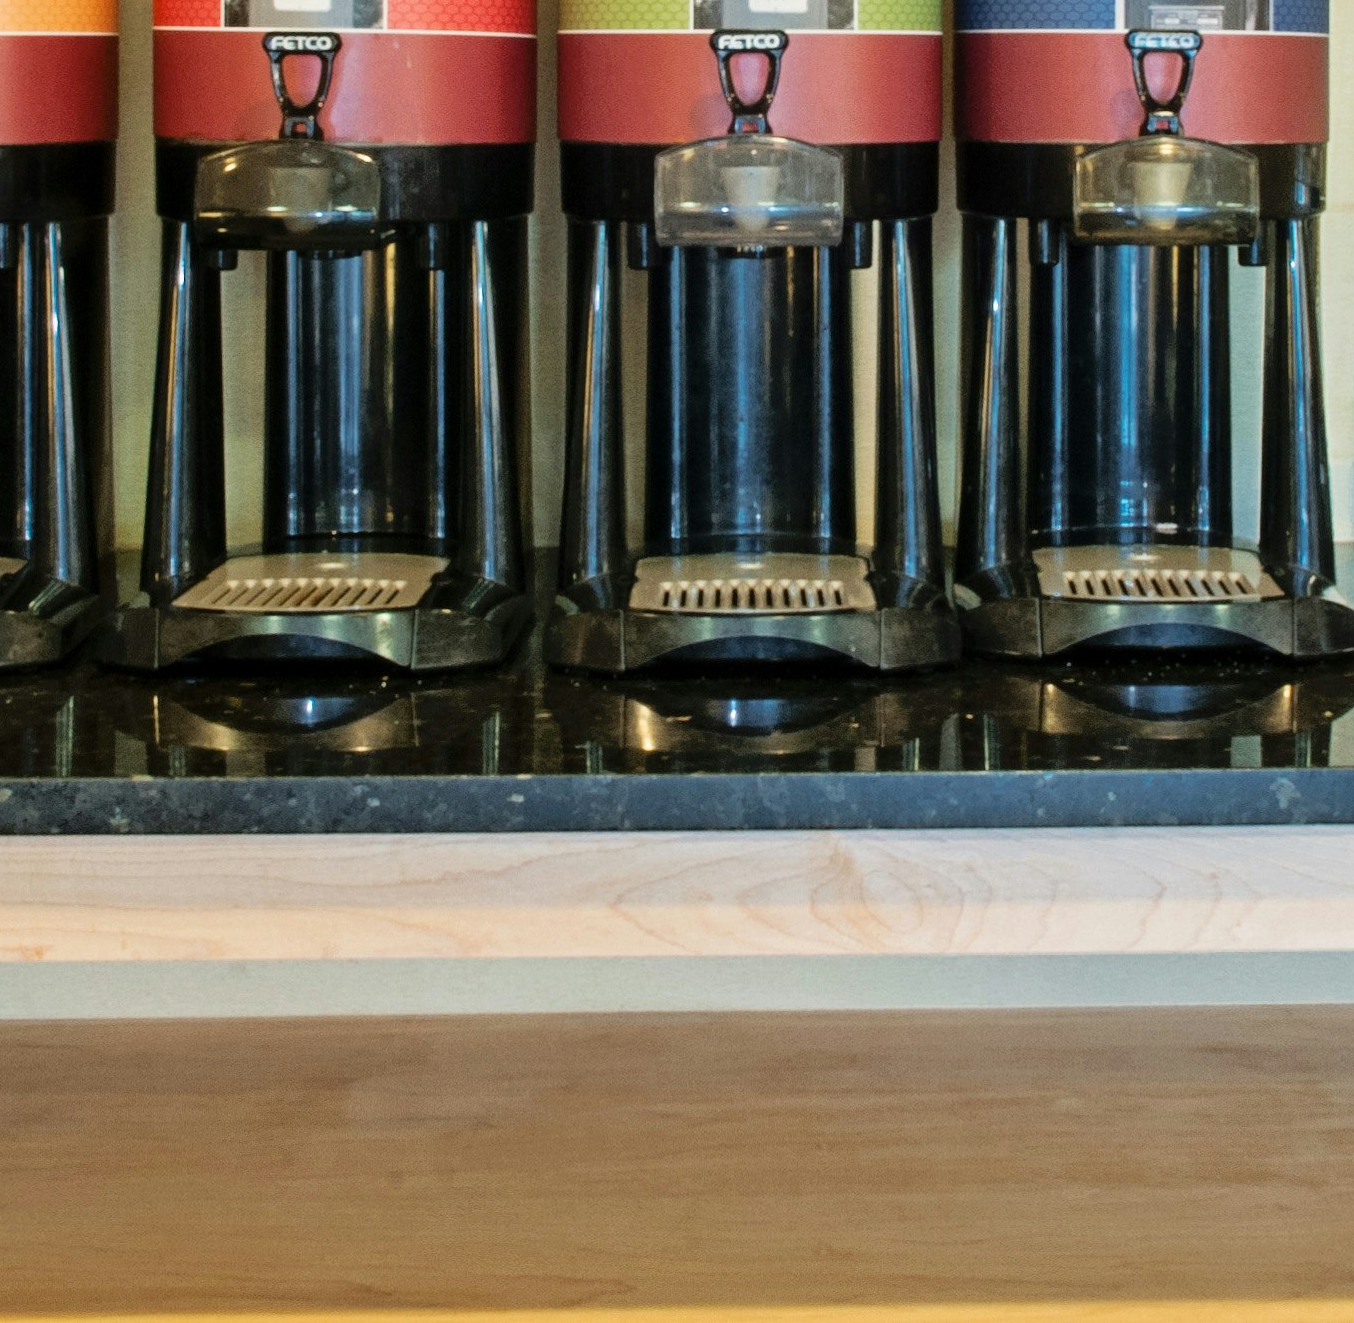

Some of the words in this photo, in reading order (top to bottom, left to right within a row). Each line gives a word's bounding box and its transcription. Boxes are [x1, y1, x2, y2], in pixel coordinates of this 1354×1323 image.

[269, 35, 333, 51] FETCO
[718, 34, 780, 49] FETCO
[1133, 34, 1196, 49] FETCO
